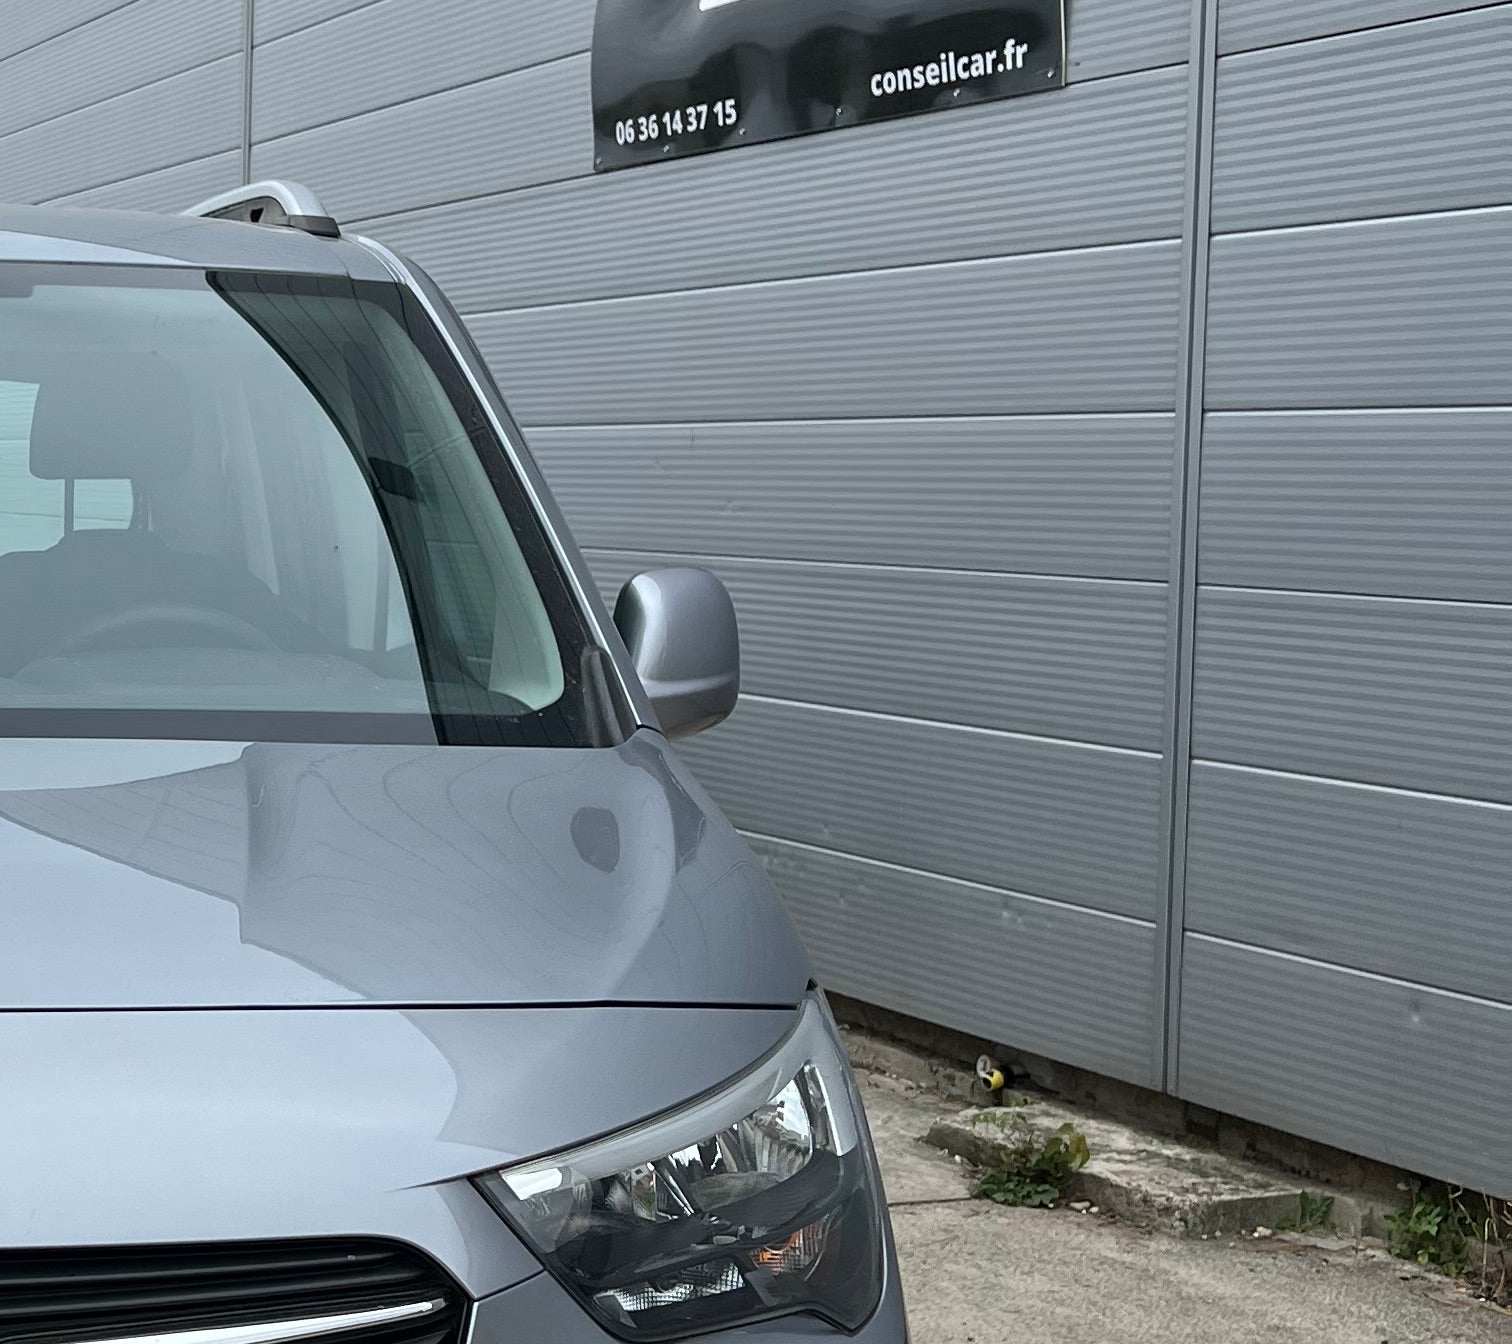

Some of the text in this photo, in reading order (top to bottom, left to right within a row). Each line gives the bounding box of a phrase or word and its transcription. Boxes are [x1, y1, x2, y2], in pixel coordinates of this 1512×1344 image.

[869, 37, 1029, 98] conseilcar.fr
[614, 97, 738, 146] 06 36 14 37 15
